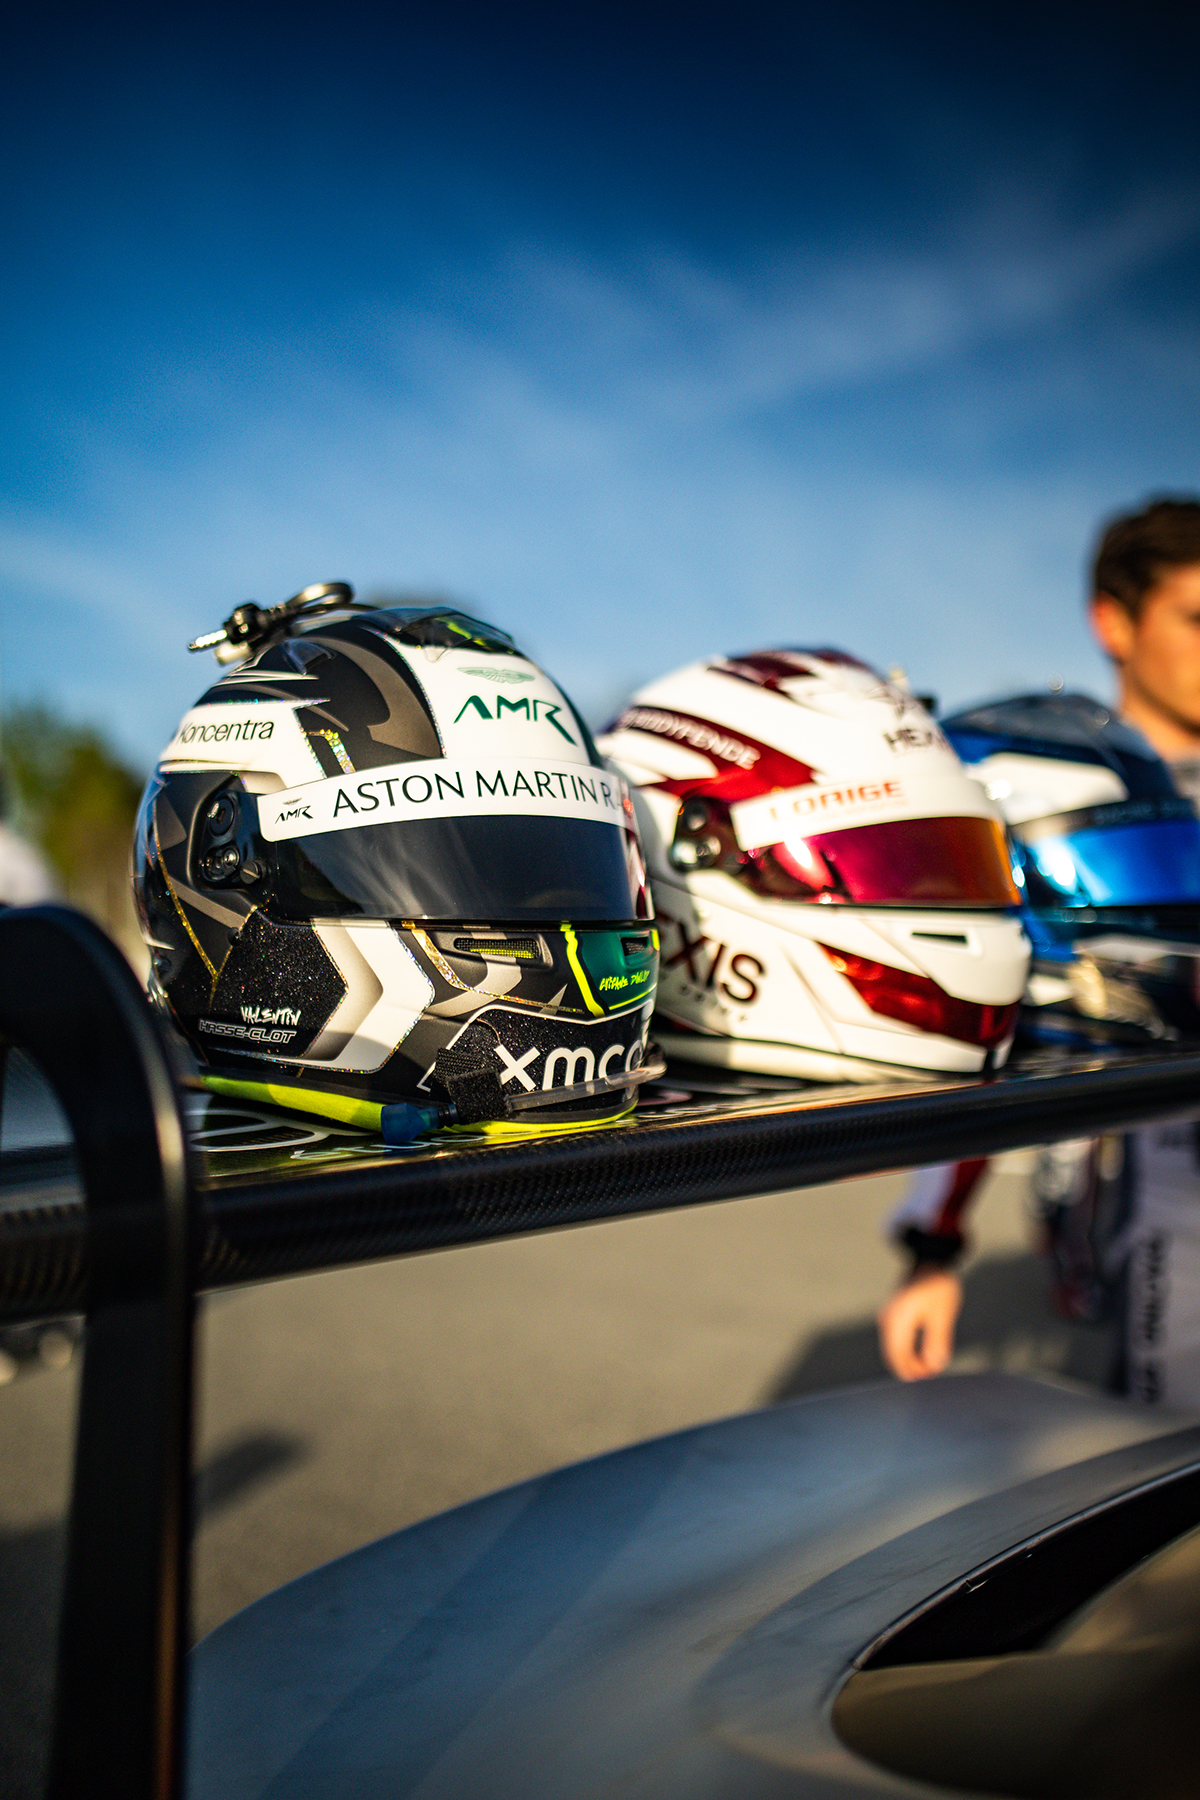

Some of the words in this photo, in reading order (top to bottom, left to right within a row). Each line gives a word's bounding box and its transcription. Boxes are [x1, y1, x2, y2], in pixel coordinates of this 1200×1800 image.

[177, 719, 275, 744] Koncentra
[453, 695, 578, 747] AMR
[333, 771, 465, 818] ASTON
[475, 770, 599, 805] MARTIN
[275, 805, 314, 824] AMR
[240, 1006, 302, 1026] VALENTIN
[198, 1019, 297, 1043] HASSE-CLOT
